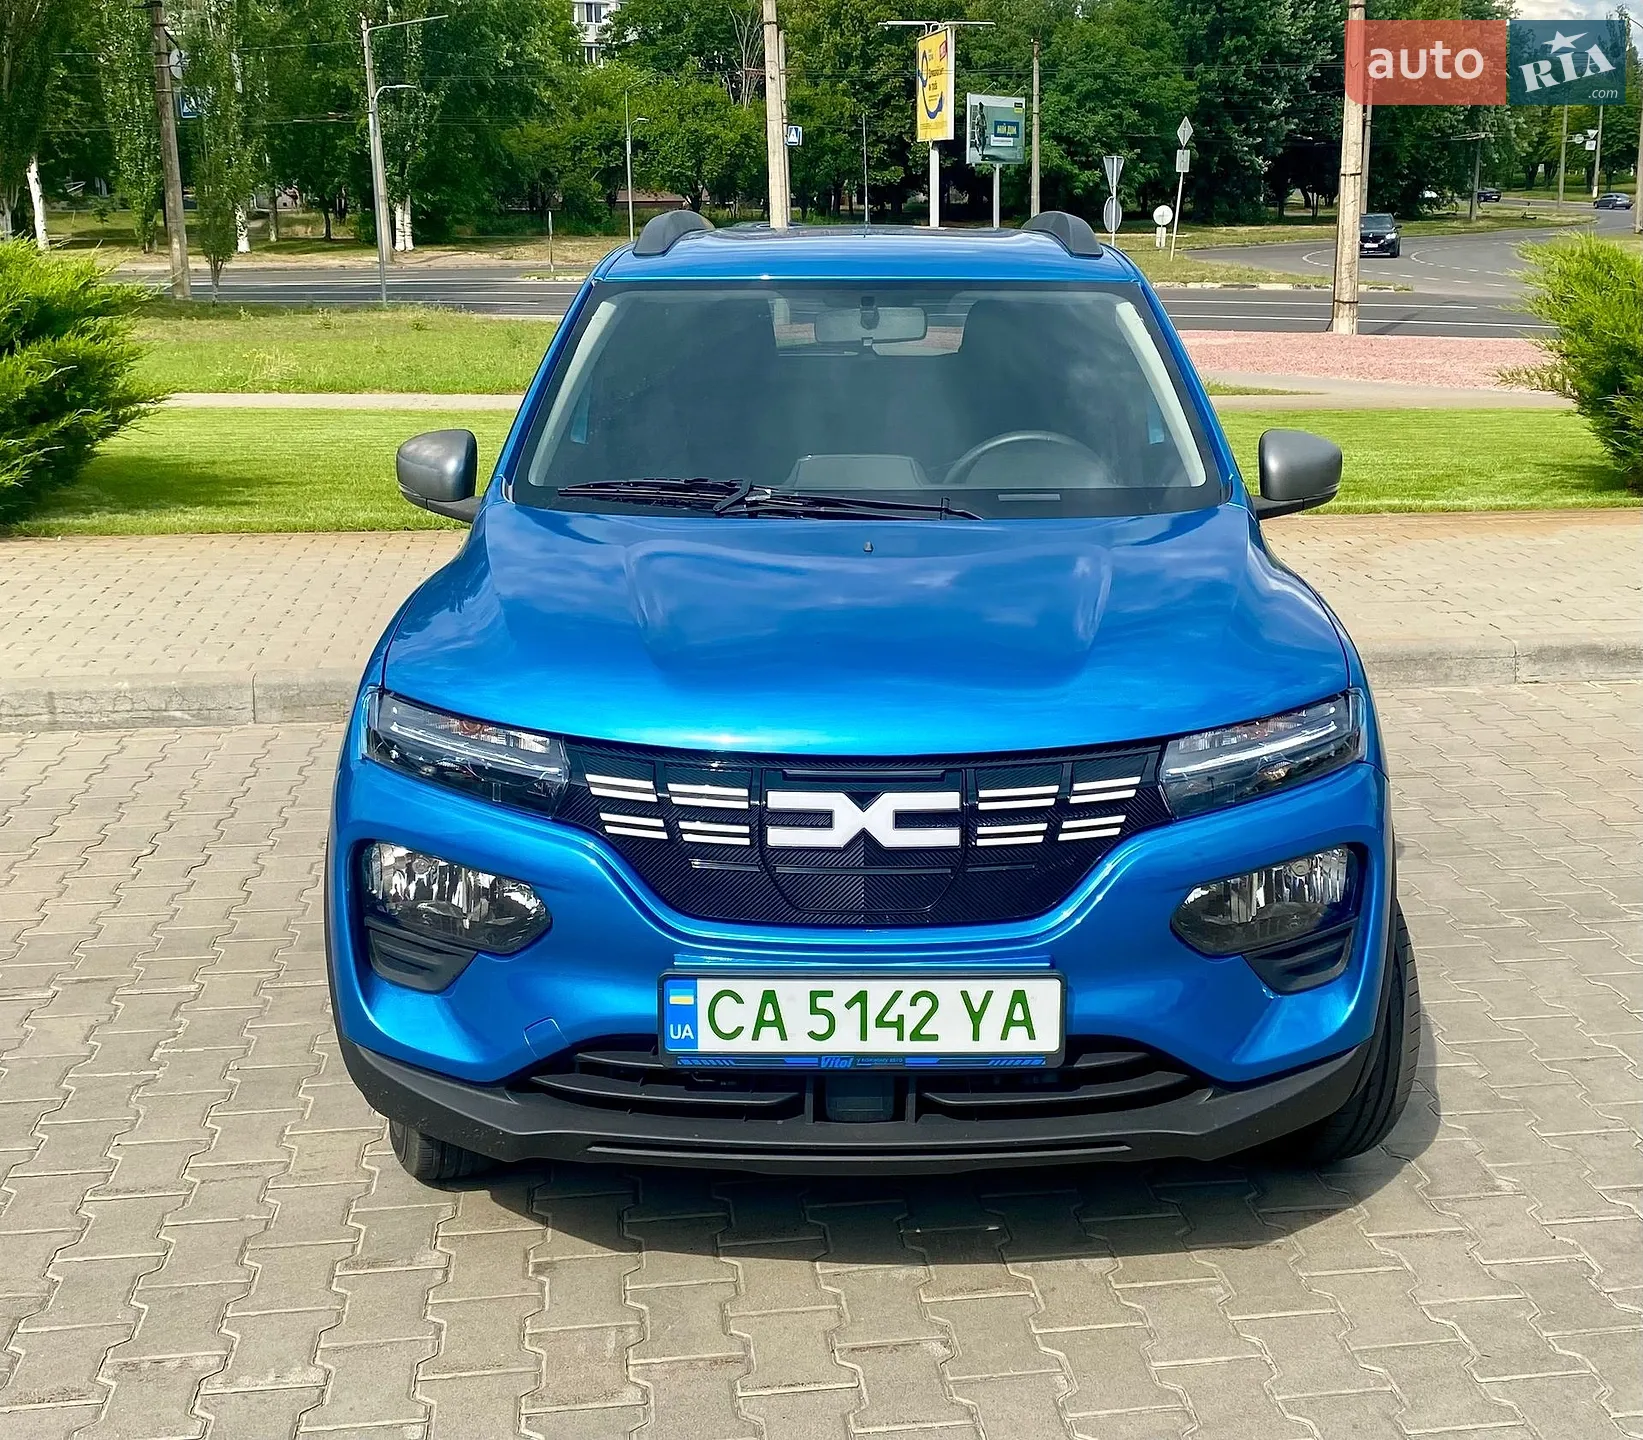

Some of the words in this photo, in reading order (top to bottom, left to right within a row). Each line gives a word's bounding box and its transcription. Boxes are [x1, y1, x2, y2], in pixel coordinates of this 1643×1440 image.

[707, 989, 788, 1041] CA
[807, 989, 939, 1042] 5142
[960, 989, 1037, 1042] YA
[669, 1023, 695, 1040] UA
[820, 1056, 854, 1068] Vitol
